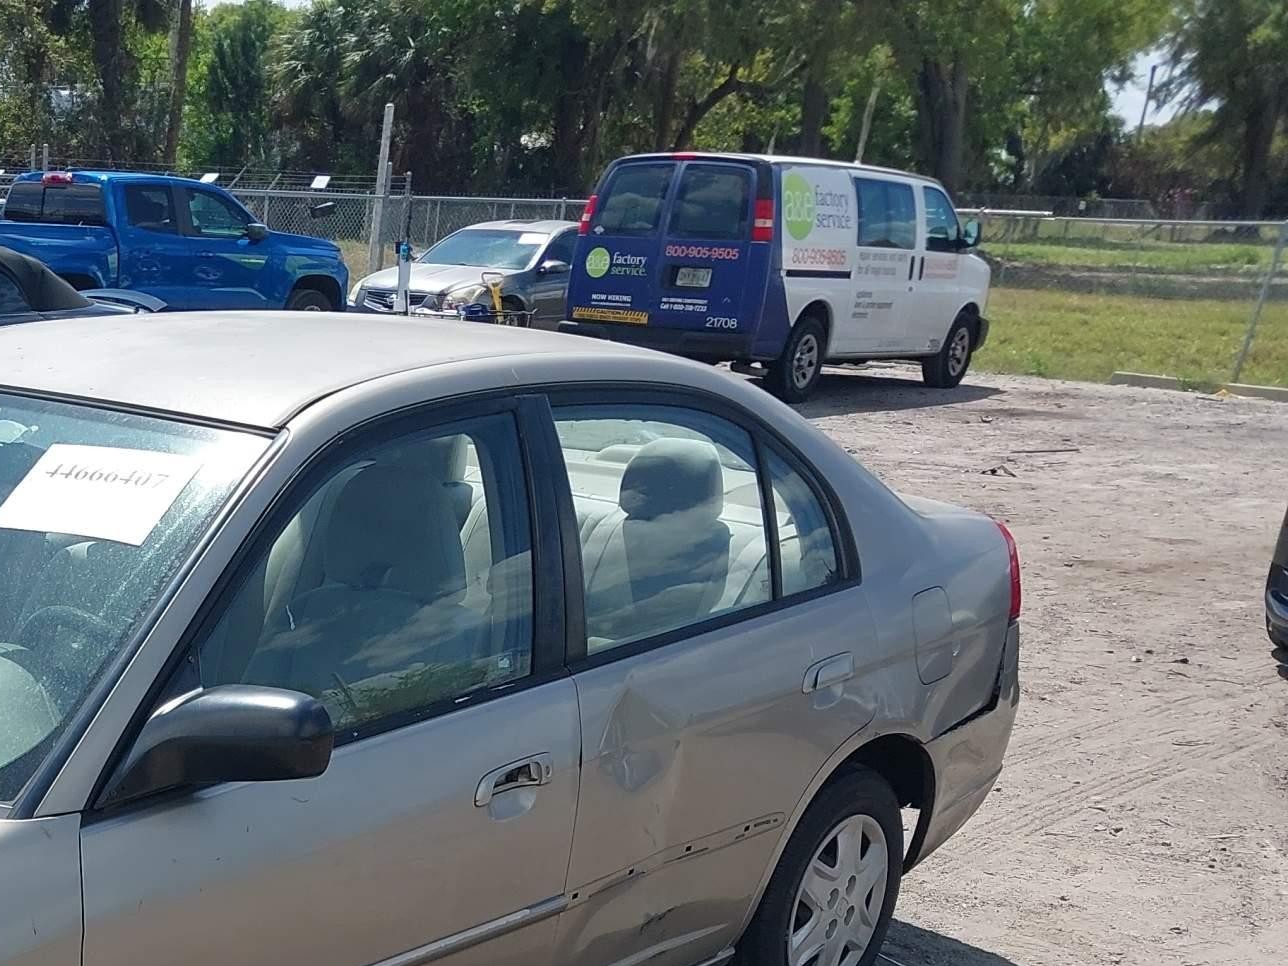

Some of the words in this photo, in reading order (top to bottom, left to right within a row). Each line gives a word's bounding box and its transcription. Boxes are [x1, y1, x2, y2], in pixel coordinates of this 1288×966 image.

[815, 185, 849, 212] factory
[613, 252, 648, 265] factory
[665, 245, 740, 260] 800-905-9505
[705, 316, 738, 329] 21708
